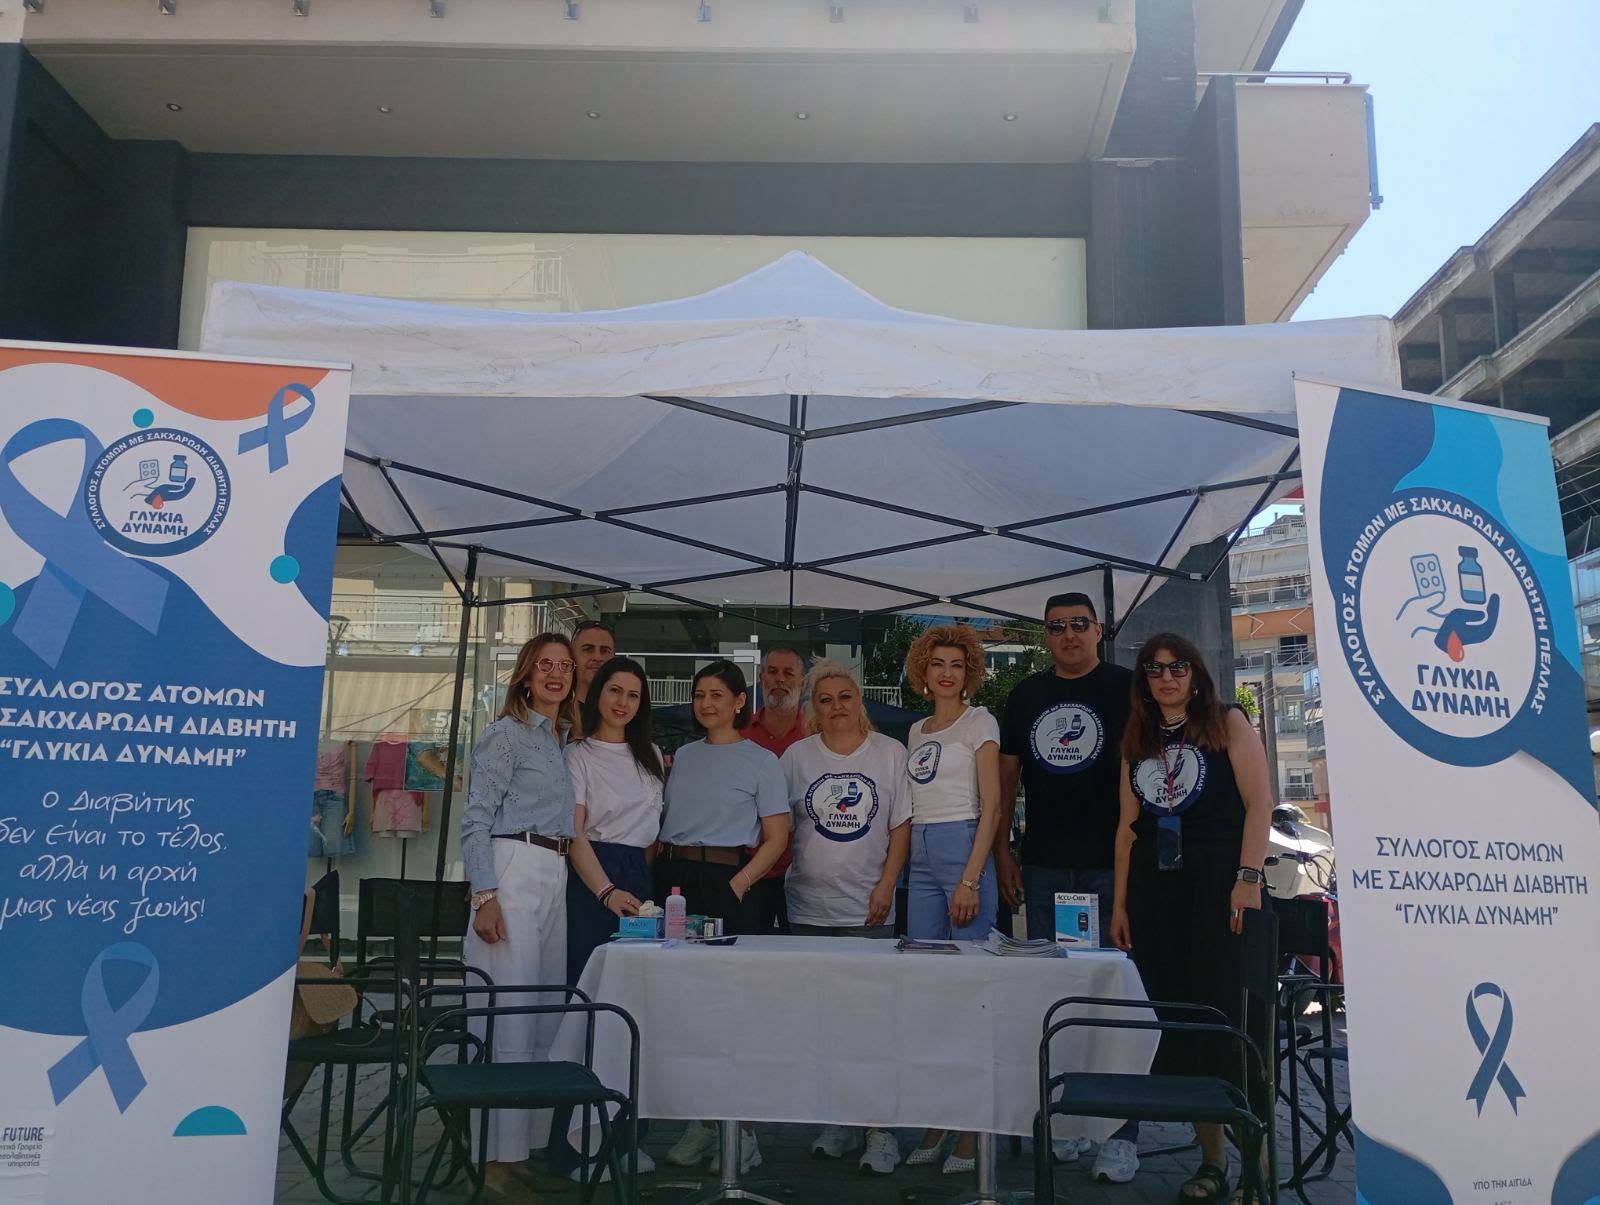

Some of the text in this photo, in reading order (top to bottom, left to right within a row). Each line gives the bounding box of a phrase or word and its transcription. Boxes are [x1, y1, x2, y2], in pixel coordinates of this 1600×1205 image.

[88, 432, 228, 536] ΣΥΛΛΟΓΟΣ ΑΤΟΜΩΝ ΜΕ ΣΑΚΧΑΡΩΔΗ ΔΙΑΒΗΤΗ ΠΕΛΛΑΣ
[121, 522, 188, 536] ΔΥΝΑΜΗ
[129, 510, 184, 524] ΓΛΥΚΙΑ
[1343, 497, 1552, 716] ΣΥΛΛΟΓΟΣ ΑΤΟΜΩΝ ΜΕ ΣΑΚΧΑΡΩΔΗ ΔΙΑΒΗΤΗ ΠΕΛΛΑΣ
[0, 676, 265, 708] ΣΥΛΛΟΓΟΣ ΑΤΟΜΩΝ
[1416, 664, 1500, 692] ΓΛΥΚΙΑ
[1411, 690, 1511, 719] ΔΥΝΑΜΗ
[0, 707, 297, 739] ΣΑΚΧΑΡΩΔΗ ΔΙΑΒΗΤΗ
[1, 739, 247, 768] “ΓΛΥΚΙΑ ΔΥΝΑΜΗ”
[1050, 746, 1080, 754] ΓΛΥΚΙΑ
[68, 790, 196, 825] Διαβήτης
[828, 813, 858, 821] ΓΛΥΚΙΑ
[0, 816, 36, 844] δεν
[118, 830, 146, 847] το
[825, 820, 861, 829] ΔΥΝΑΜΗ
[1375, 836, 1564, 863] ΣΥΛΛΟΓΟΣ ΑΤΟΜΩΝ
[20, 854, 89, 882] αλλά
[127, 861, 198, 897] αρχή
[1352, 869, 1589, 895] ΜΕ ΣΑΚΧΑΡΩΔΗ ΔΙΑΒΗΤΗ
[0, 897, 57, 930] μιας
[67, 893, 120, 922] νέας
[1395, 903, 1559, 926] “ΓΛΥΚΙΑ ΔΥΝΑΜΗ”
[3, 1126, 45, 1142] FUTURE
[1473, 1180, 1490, 1190] ΥΠΟ
